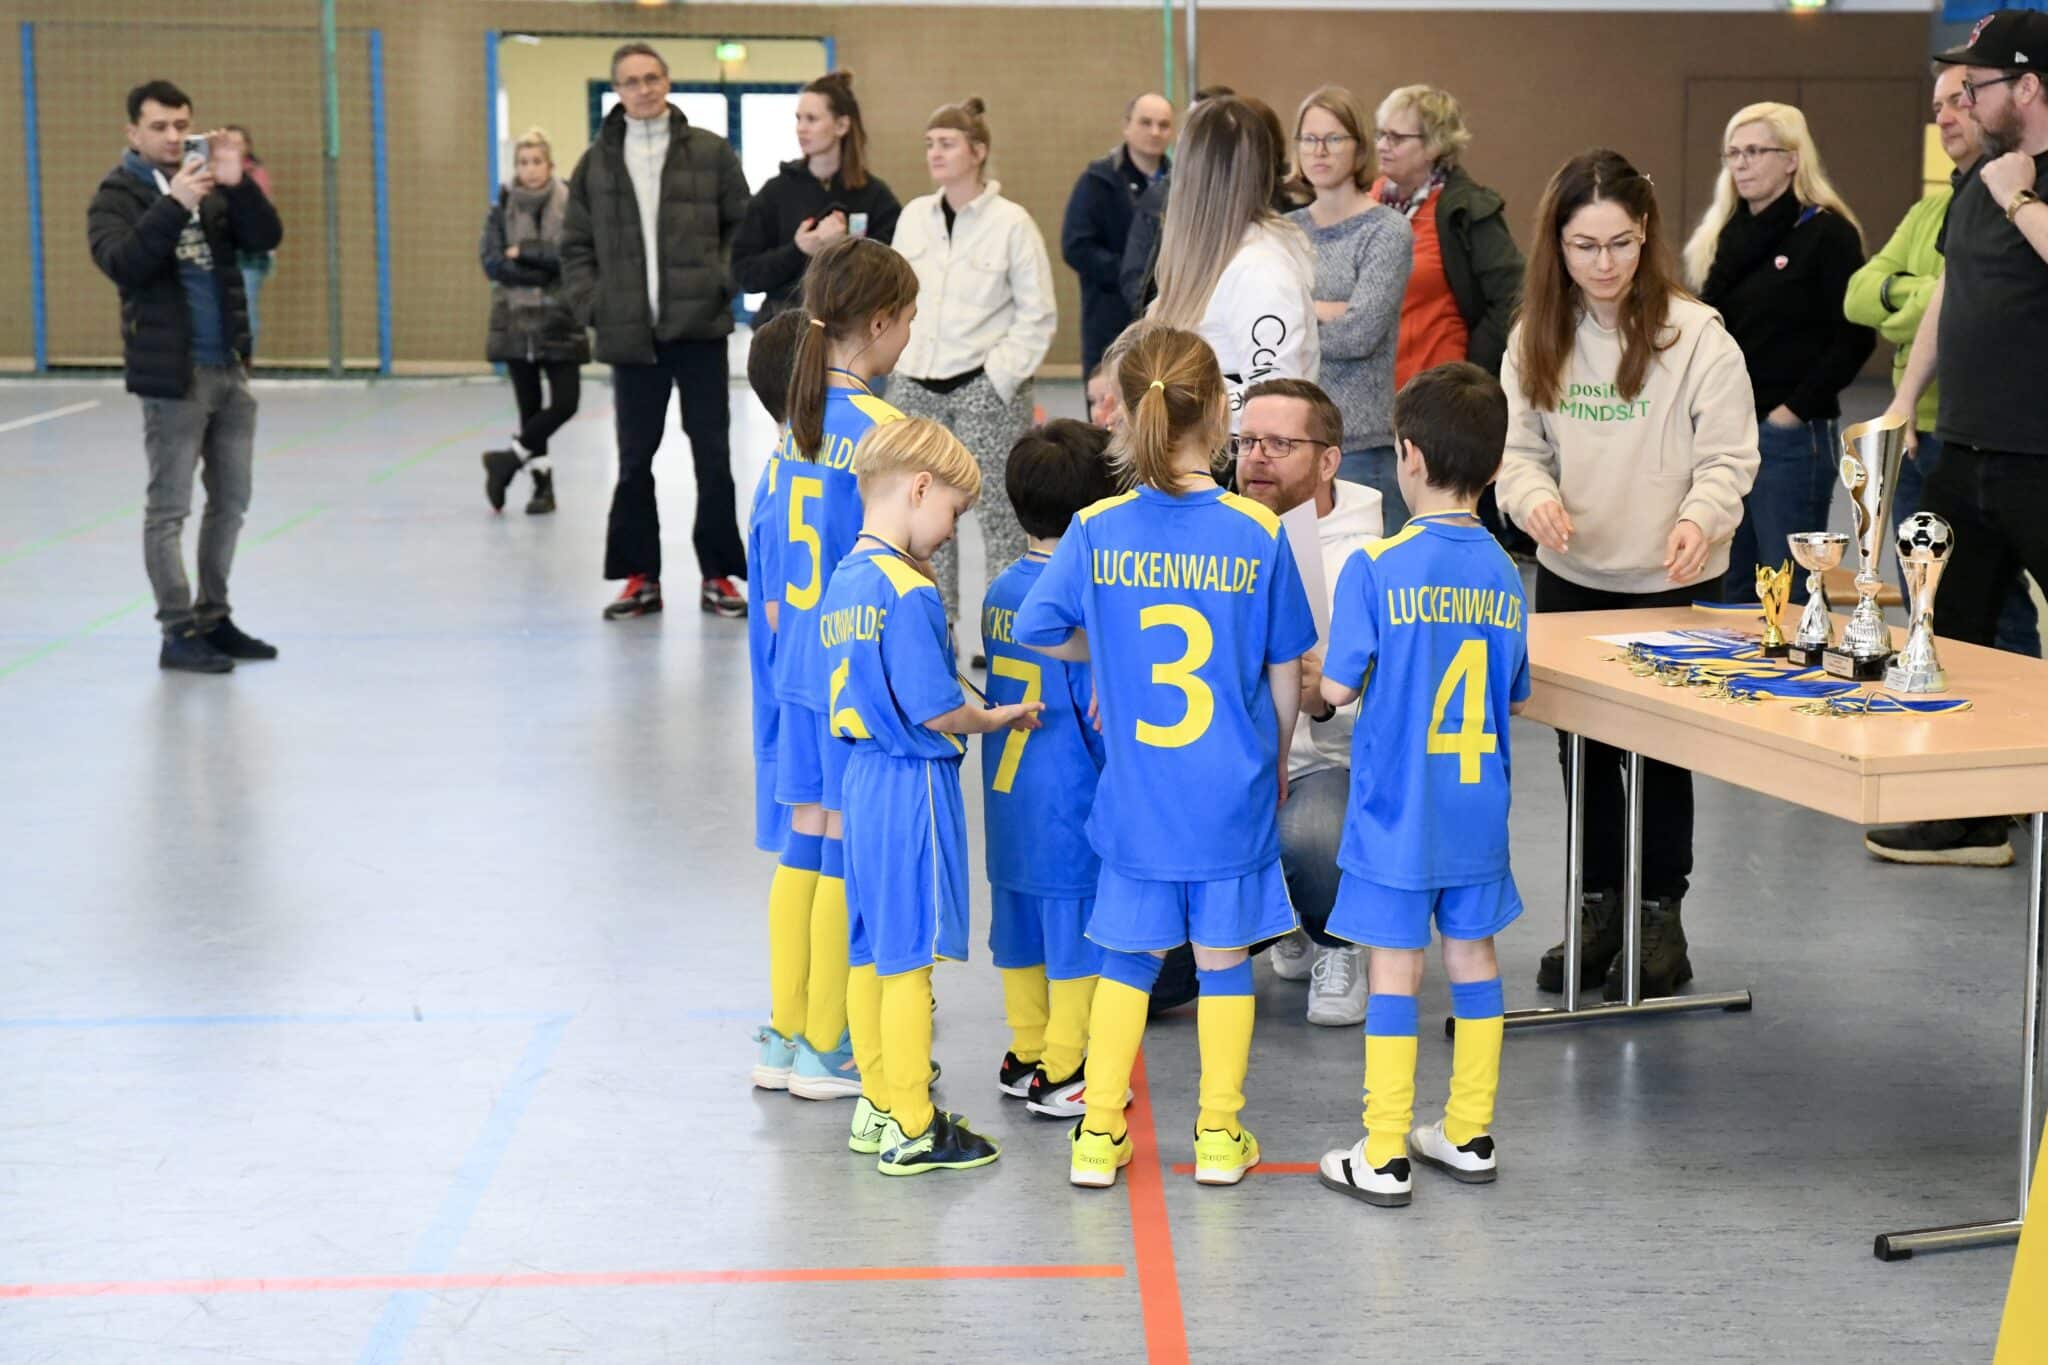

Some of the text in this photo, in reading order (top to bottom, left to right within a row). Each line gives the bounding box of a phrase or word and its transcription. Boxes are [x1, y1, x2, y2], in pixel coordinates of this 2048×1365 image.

[785, 475, 823, 611] 5
[1093, 548, 1261, 594] LUCKENWALDE
[1387, 585, 1522, 632] LUCKENWALDE
[991, 655, 1042, 794] 7
[1135, 603, 1215, 748] 3
[1426, 639, 1497, 784] 4
